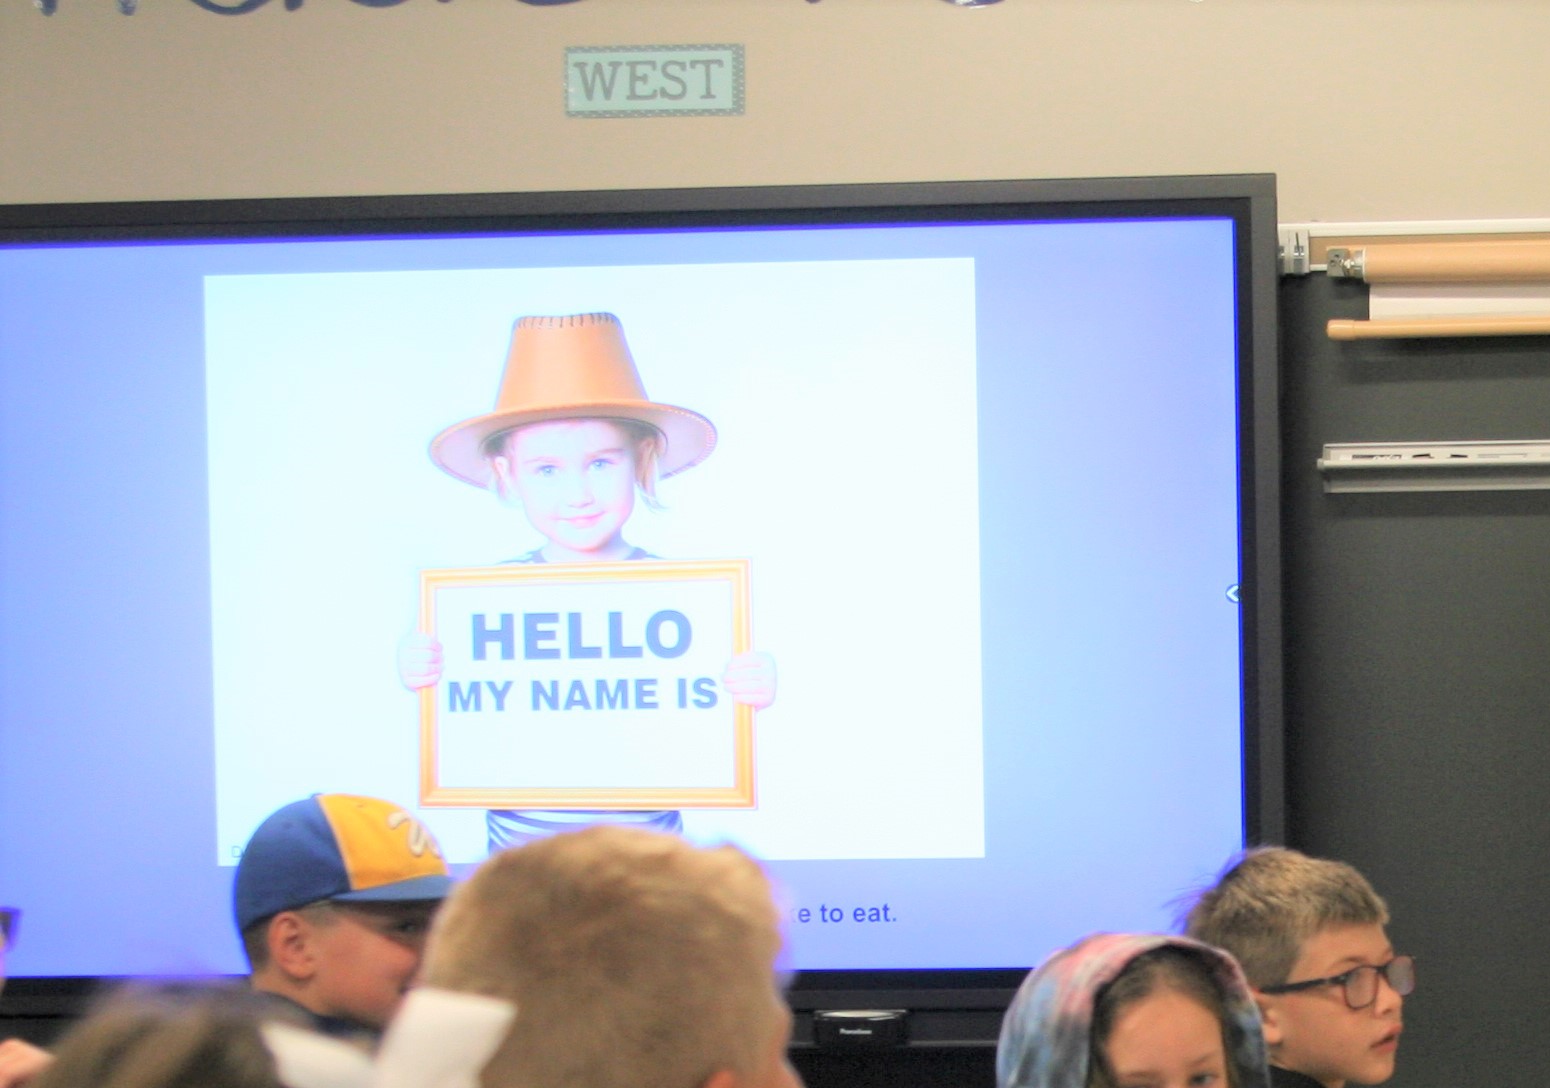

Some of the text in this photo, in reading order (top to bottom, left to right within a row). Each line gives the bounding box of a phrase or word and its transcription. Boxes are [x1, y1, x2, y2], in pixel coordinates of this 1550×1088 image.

[573, 59, 724, 101] WEST
[471, 609, 693, 661] HELLO
[448, 676, 718, 713] MY NAME IS
[820, 904, 844, 923] to
[853, 904, 897, 923] eat.
